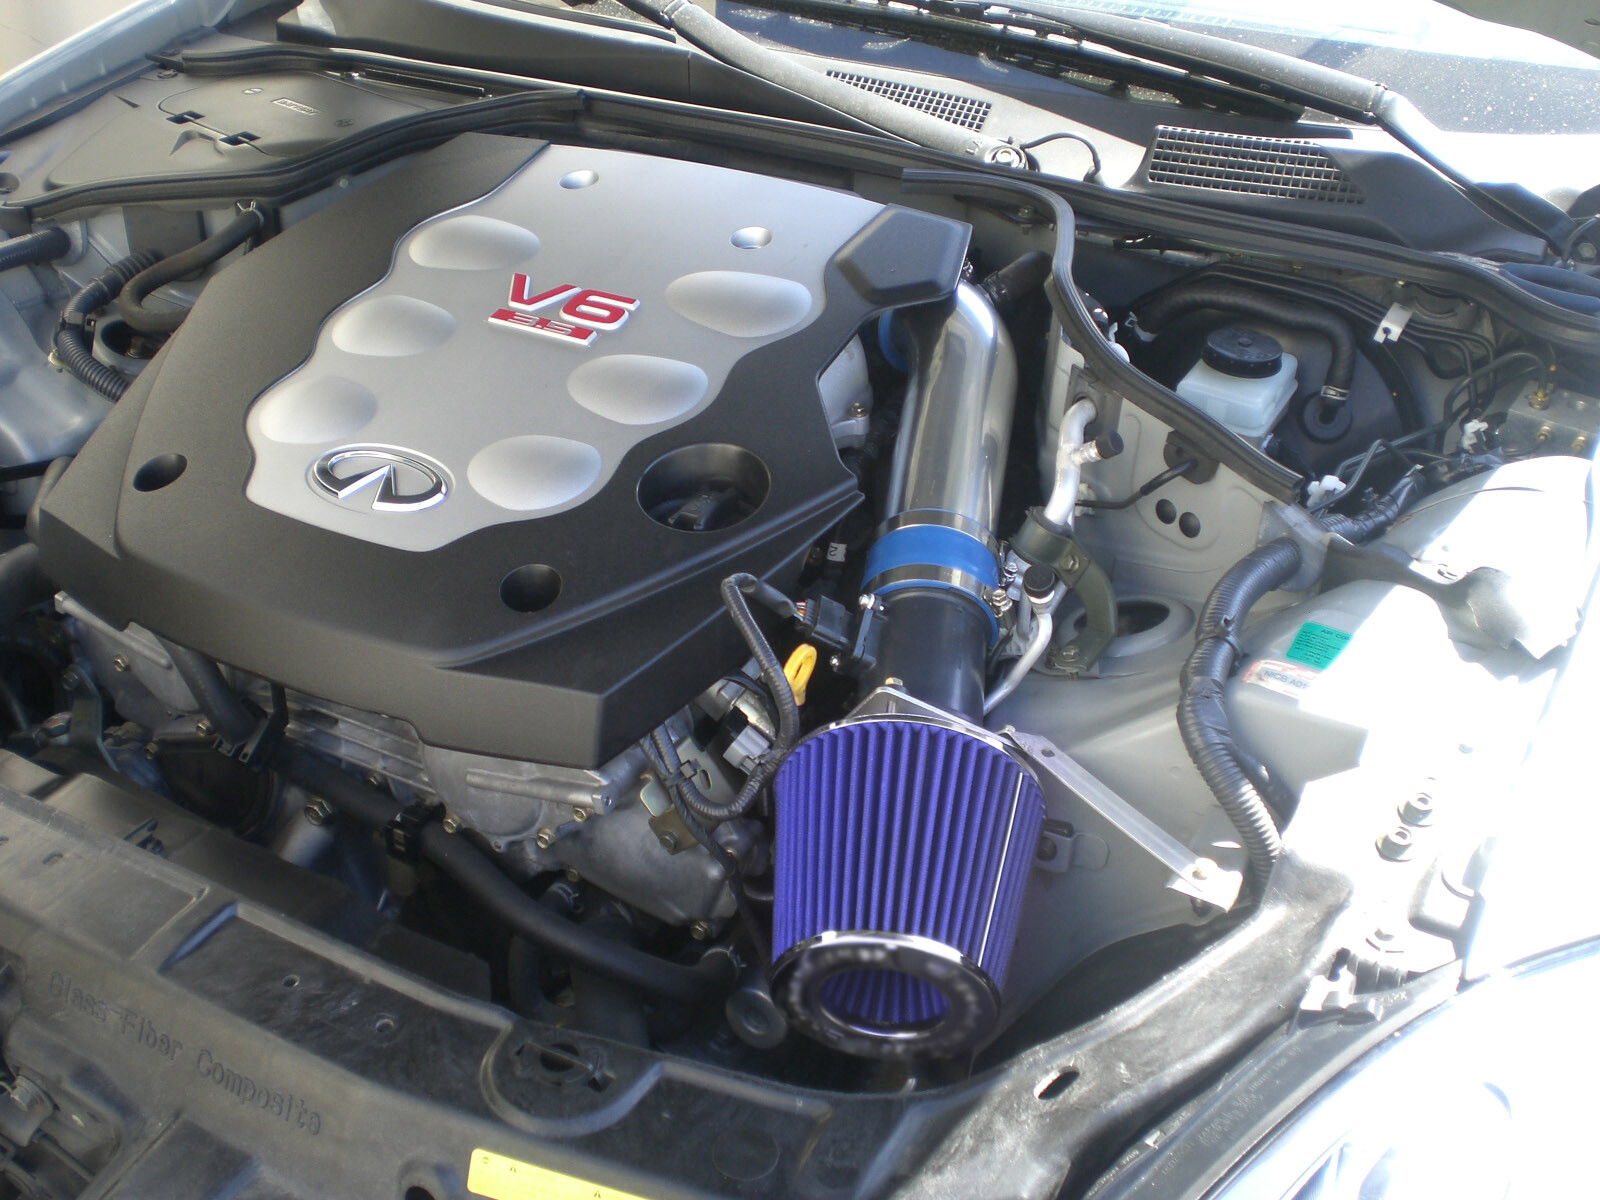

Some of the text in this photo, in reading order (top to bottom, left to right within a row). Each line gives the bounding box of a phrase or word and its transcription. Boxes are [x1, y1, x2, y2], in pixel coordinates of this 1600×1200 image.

[507, 312, 576, 336] 3.5
[508, 273, 640, 331] V6
[197, 1049, 321, 1135] Composite
